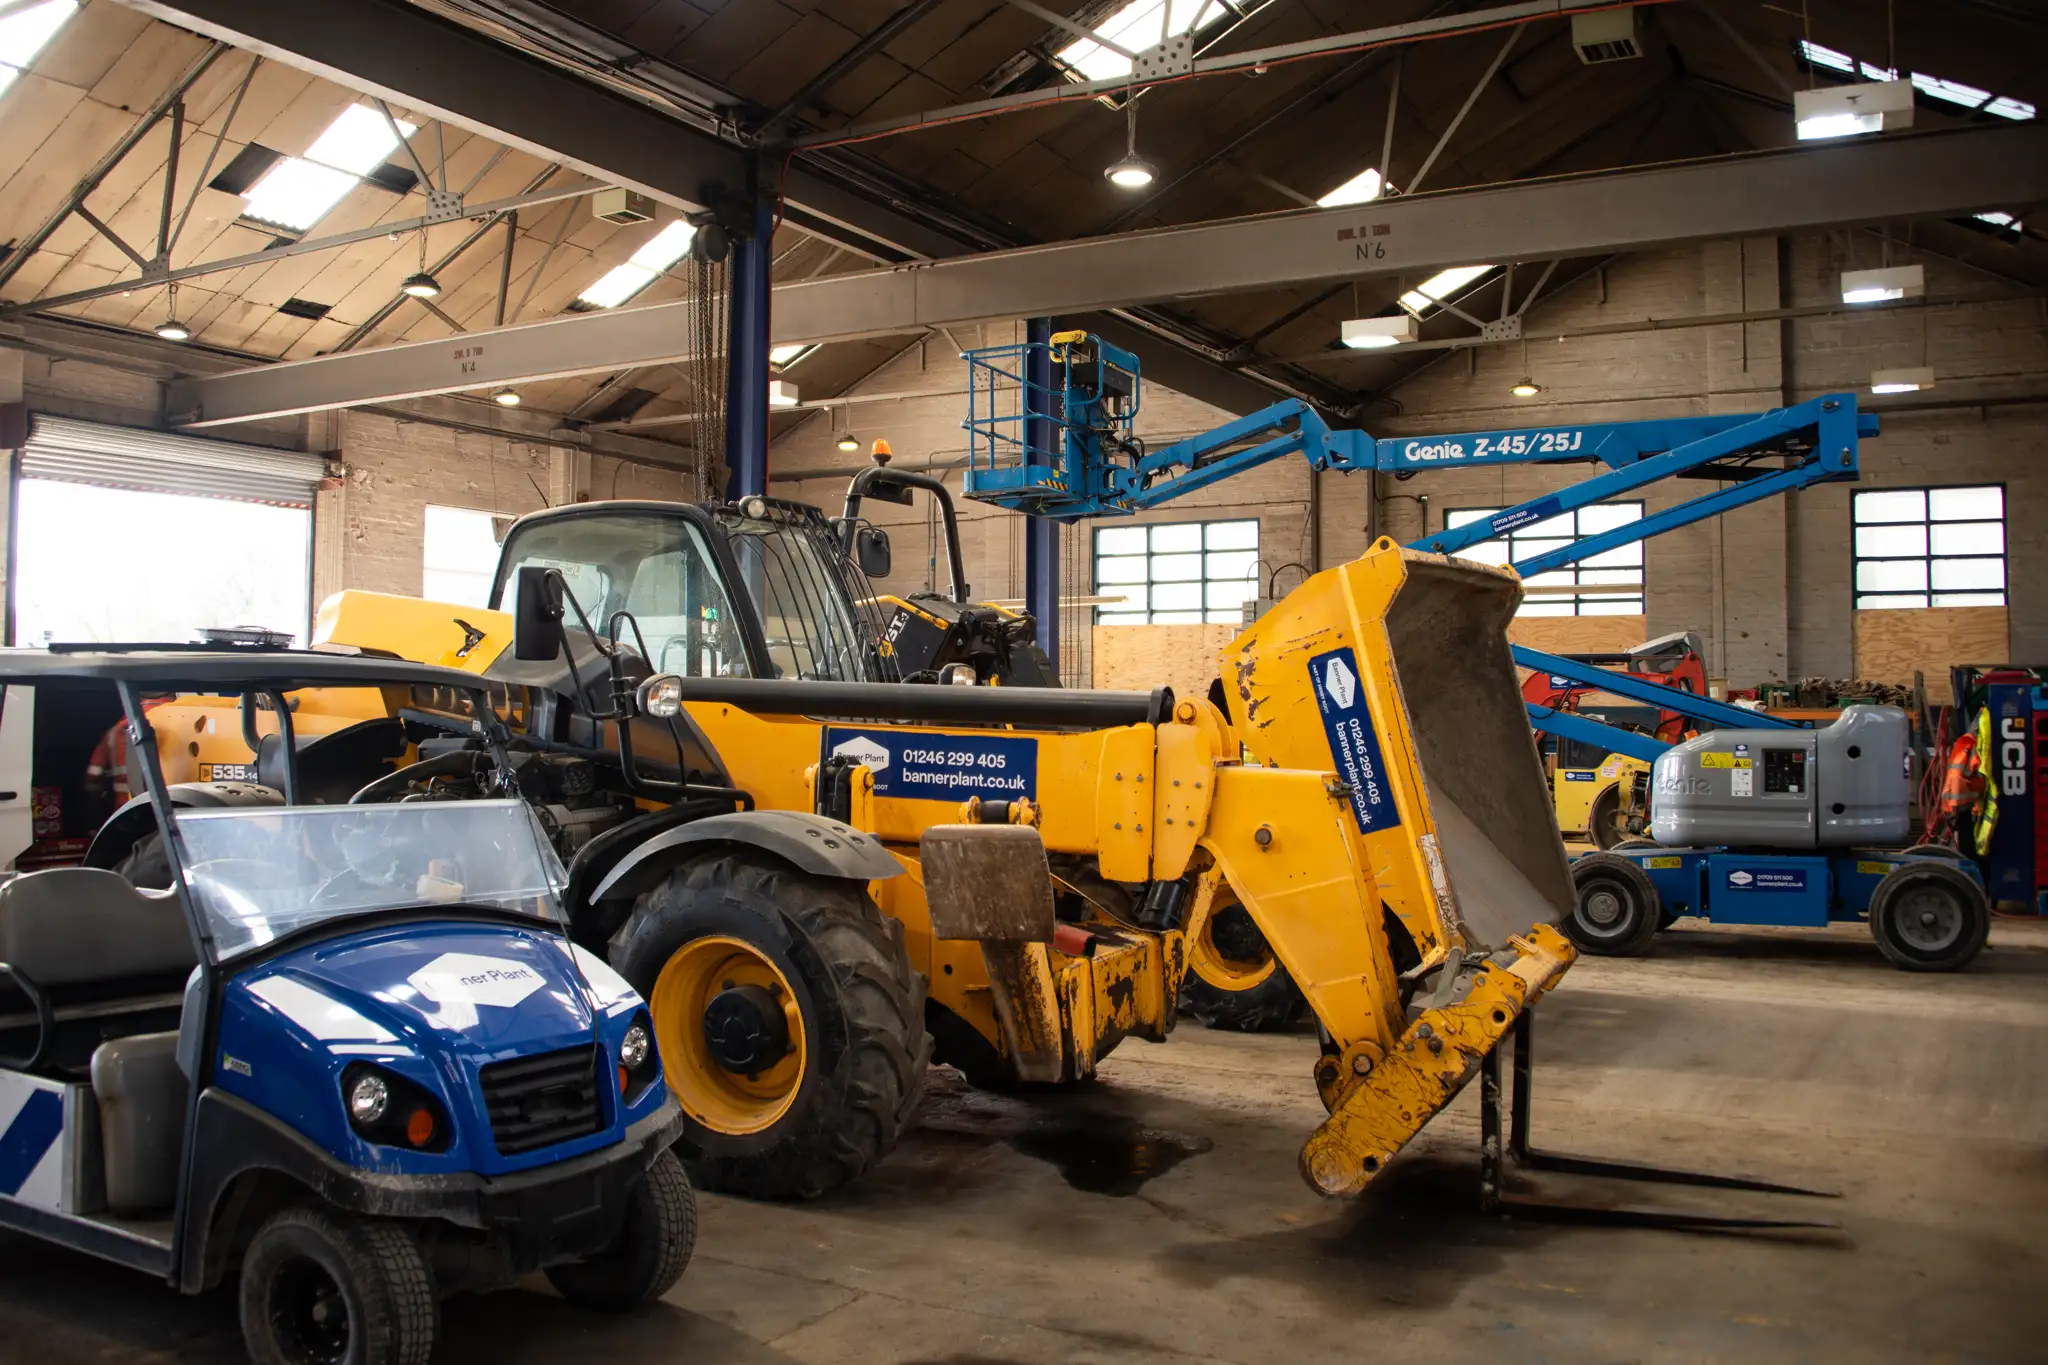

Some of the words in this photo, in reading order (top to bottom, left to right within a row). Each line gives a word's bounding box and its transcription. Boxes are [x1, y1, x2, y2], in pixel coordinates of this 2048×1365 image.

[1405, 441, 1463, 461] Genie
[1473, 432, 1582, 457] Z-45/25J
[1331, 661, 1343, 686] Banner
[1339, 686, 1349, 705] Plant
[1349, 718, 1367, 754] 01246
[865, 753, 885, 763] Plant
[903, 749, 945, 765] 01246
[947, 751, 975, 767] 299
[977, 753, 1006, 769] 405
[1359, 755, 1374, 779] 299
[2001, 717, 2026, 796] JCB
[902, 768, 1026, 791] bannerplant.co.uk
[1335, 721, 1373, 825] bannerplant.co.uk
[1366, 780, 1381, 805] 405
[486, 968, 532, 982] Plant
